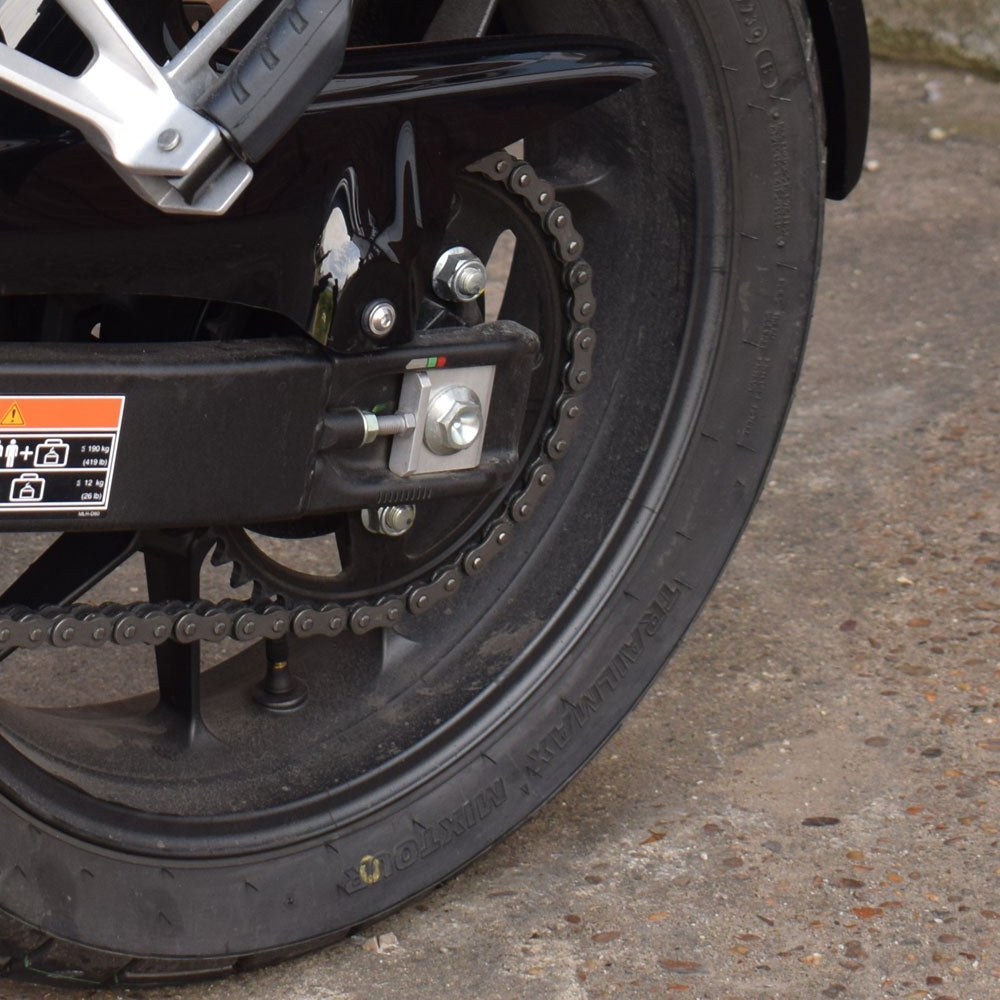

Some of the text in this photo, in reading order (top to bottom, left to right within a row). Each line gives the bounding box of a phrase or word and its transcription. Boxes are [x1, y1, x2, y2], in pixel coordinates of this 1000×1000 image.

[88, 445, 100, 453] 190
[101, 446, 110, 454] kg
[96, 480, 105, 488] kg
[527, 580, 682, 763] TRAILMAX
[344, 776, 508, 896] MIXTOUR
